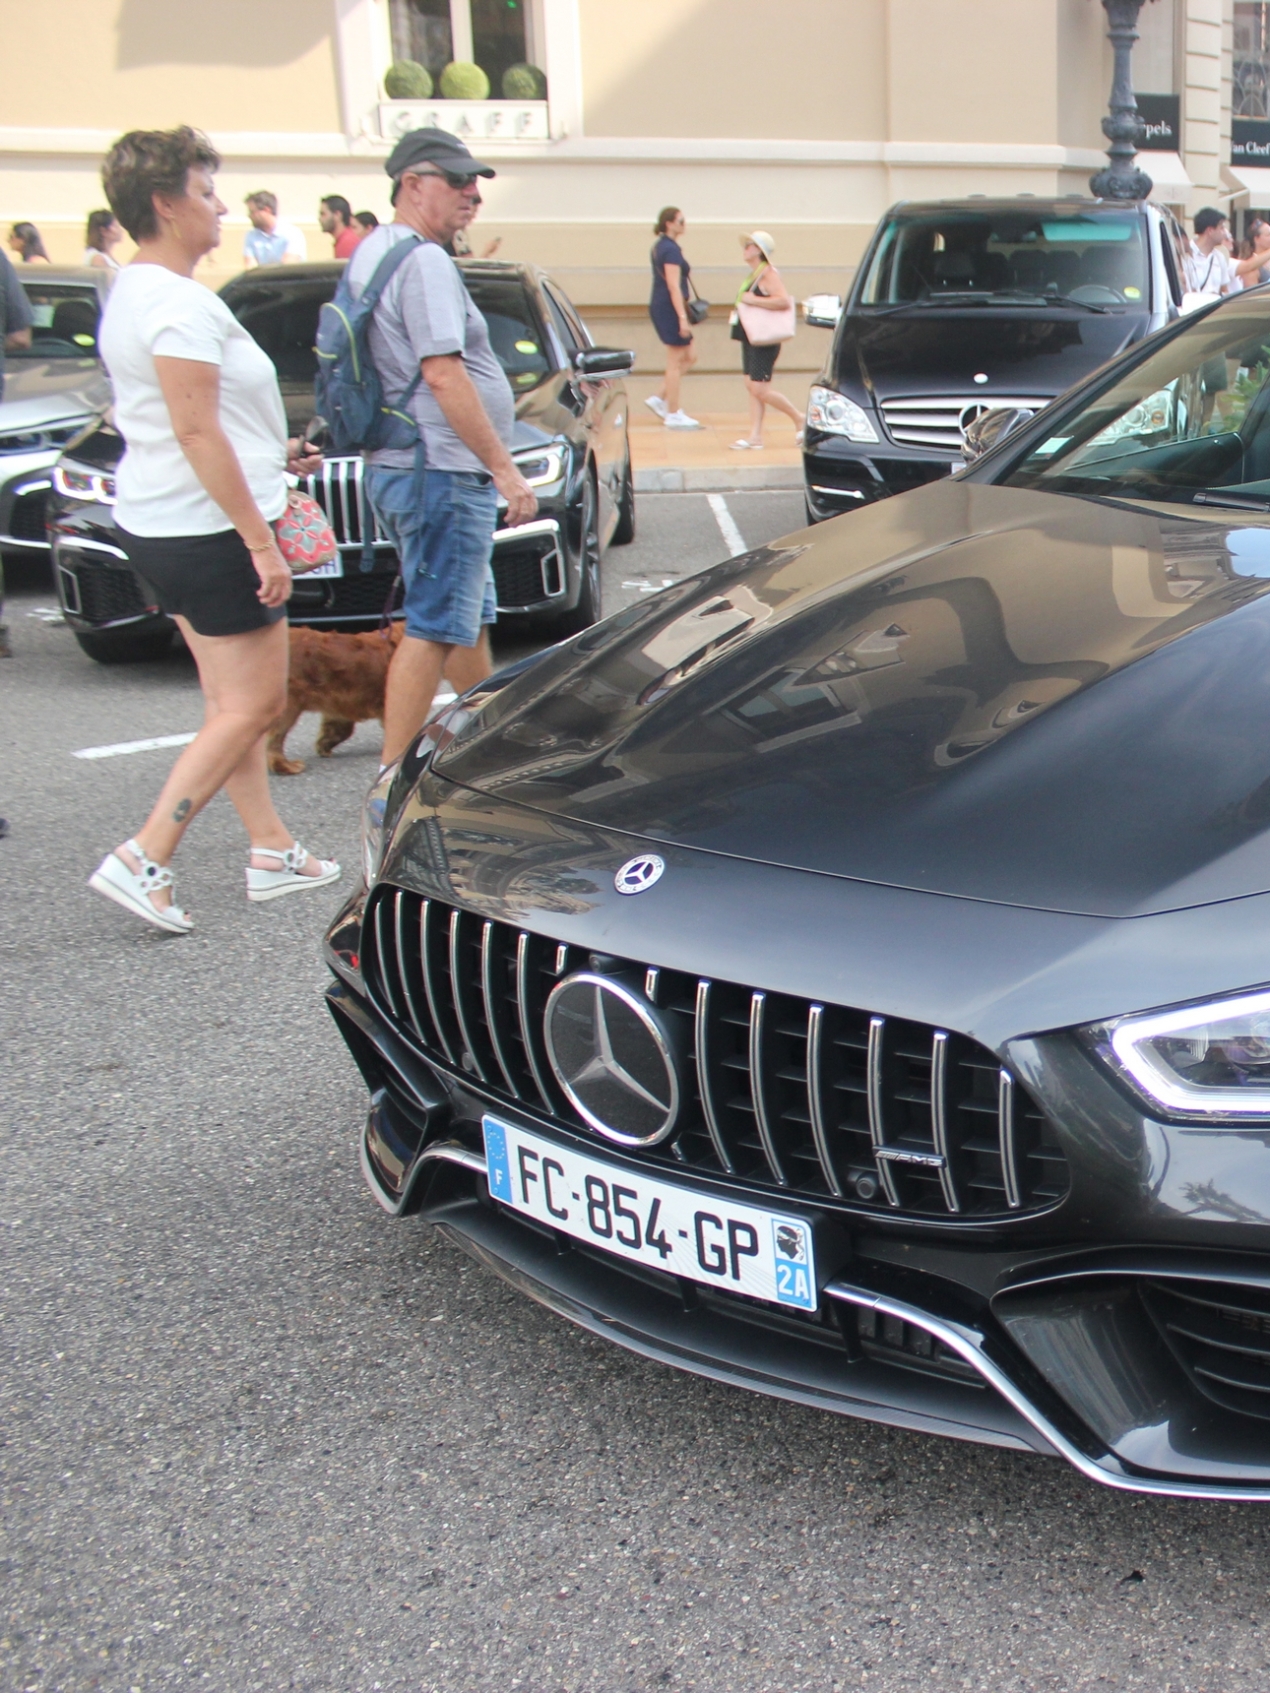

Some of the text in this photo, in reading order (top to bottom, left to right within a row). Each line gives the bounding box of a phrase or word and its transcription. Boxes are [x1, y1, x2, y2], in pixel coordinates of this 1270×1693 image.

[392, 110, 533, 137] GRAFF
[495, 1168, 503, 1186] F
[516, 1144, 760, 1281] FC-854-GP
[776, 1264, 810, 1299] 2A
